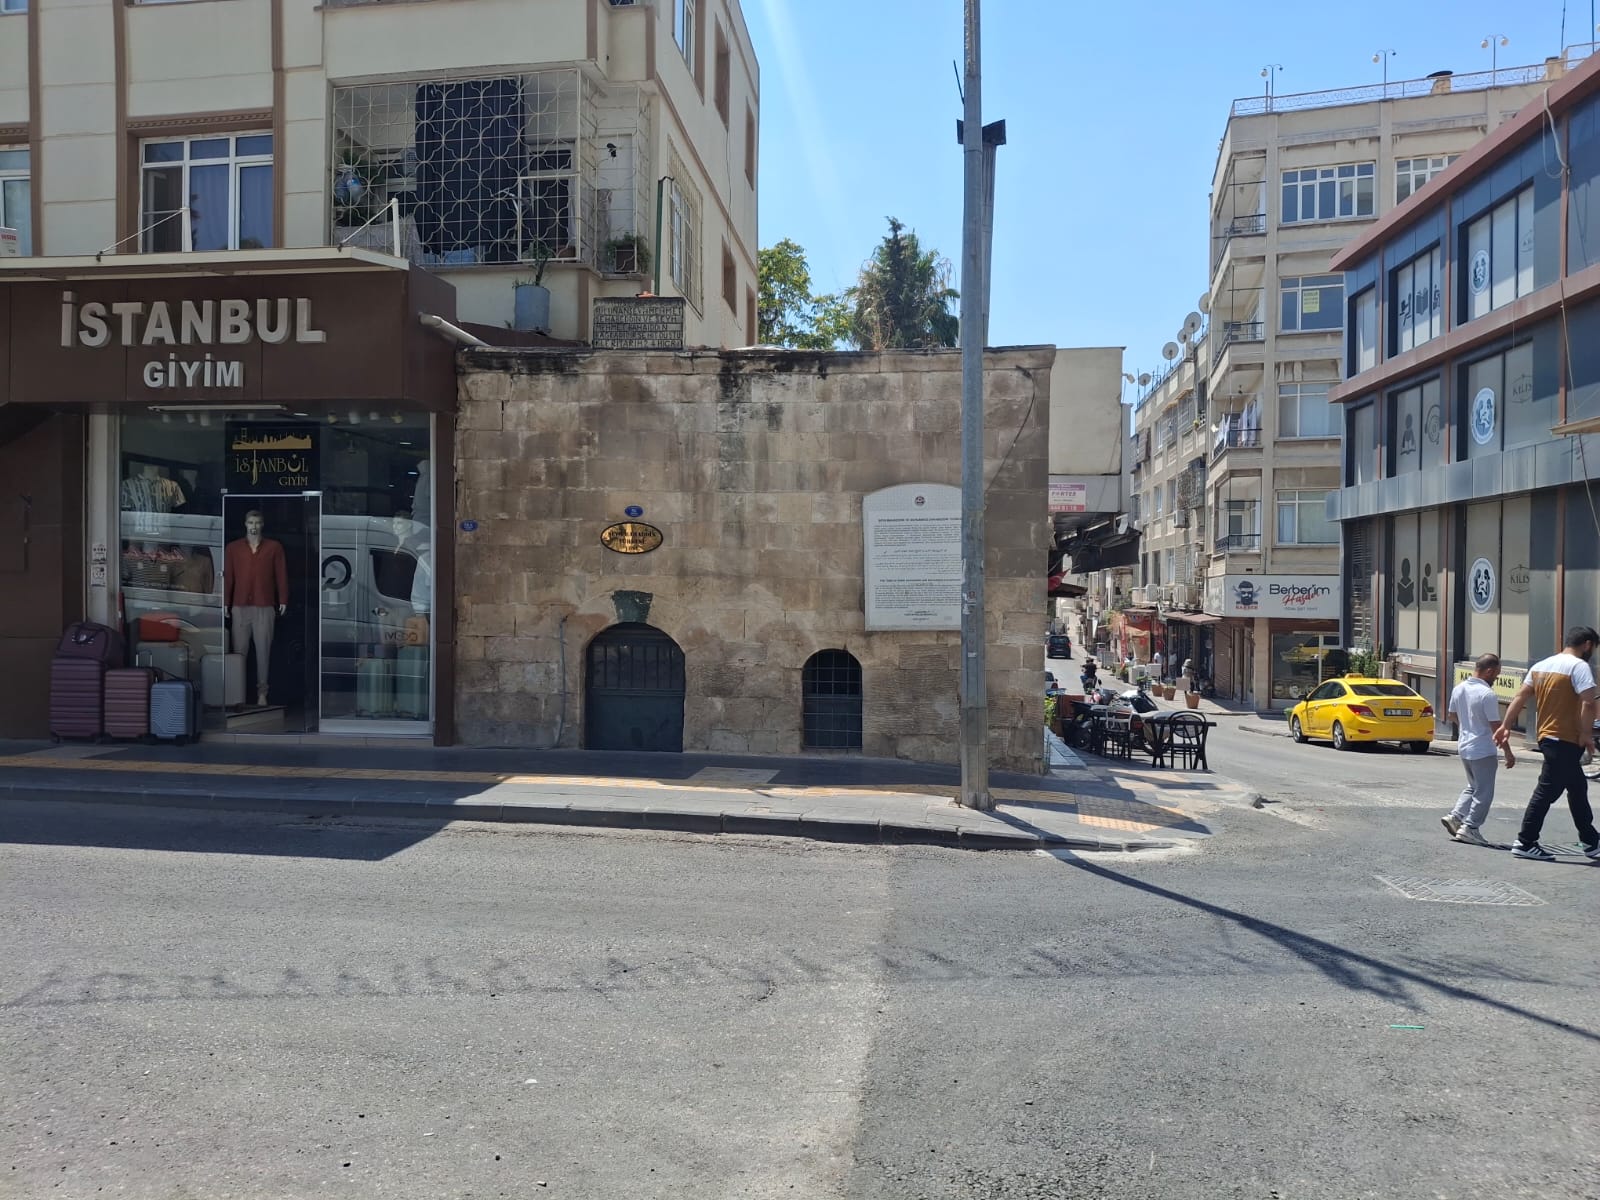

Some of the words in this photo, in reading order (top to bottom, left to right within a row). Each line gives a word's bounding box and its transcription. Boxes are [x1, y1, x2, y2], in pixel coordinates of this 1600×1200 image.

[61, 291, 326, 348] İSTANBUL
[143, 353, 244, 389] GİYİM
[1269, 584, 1330, 595] Berberim
